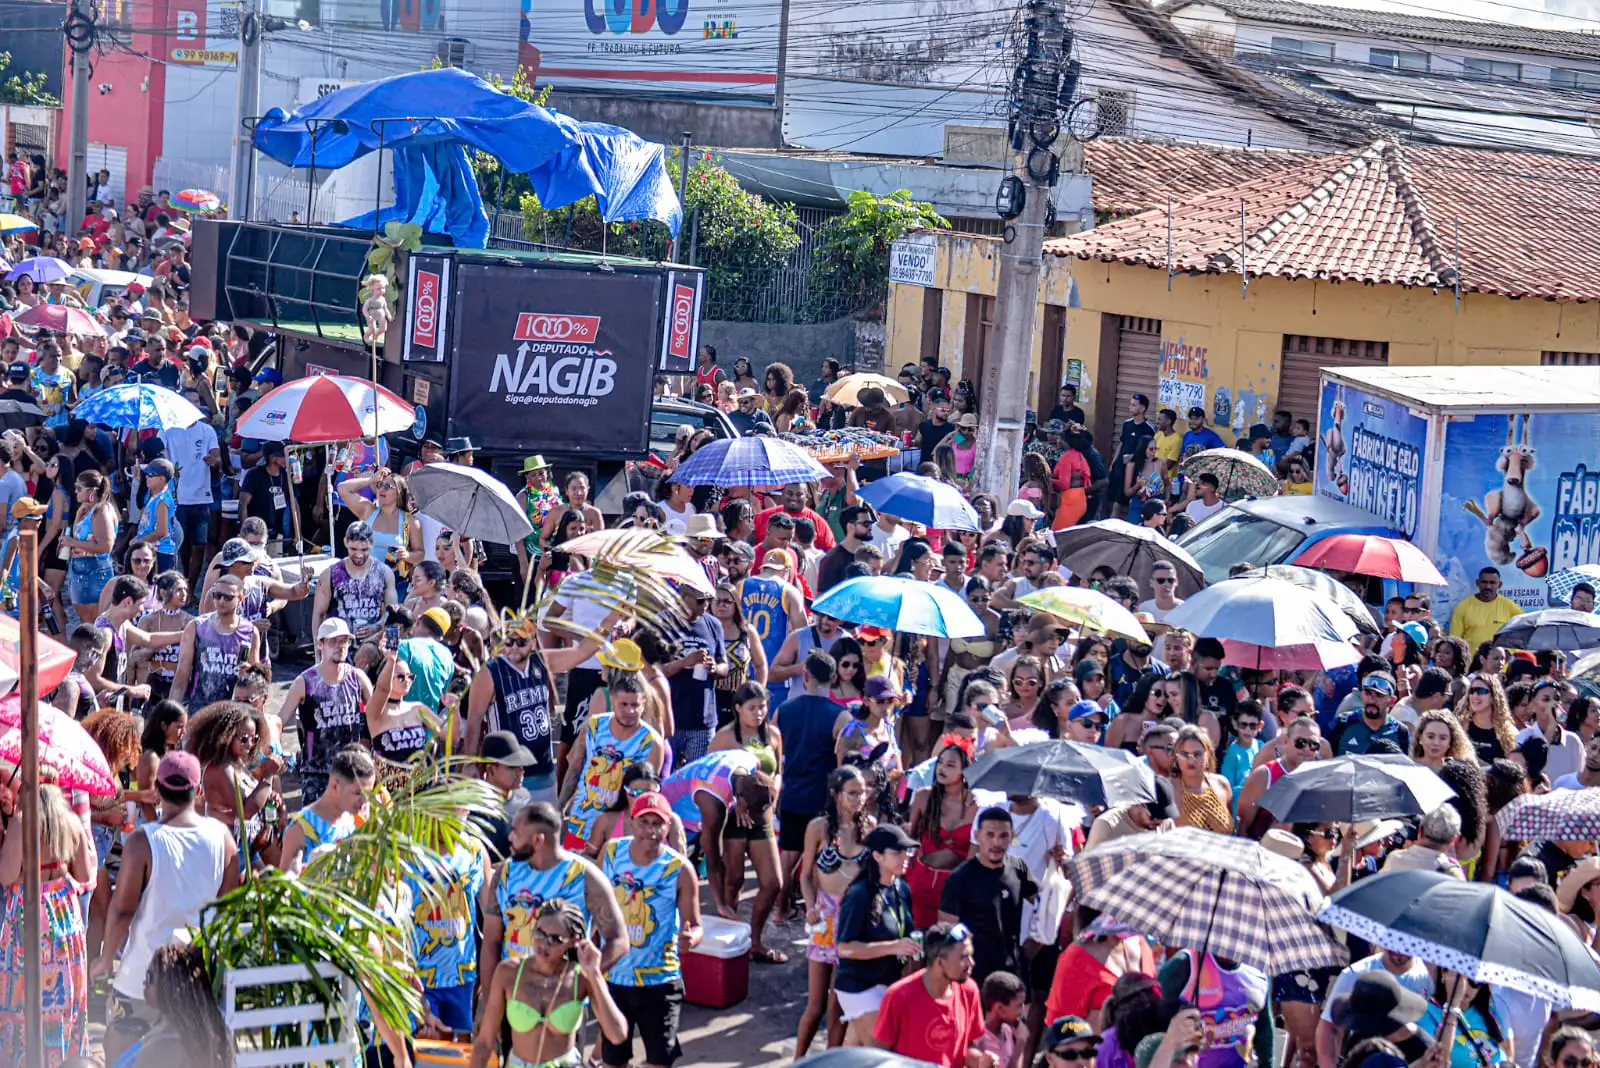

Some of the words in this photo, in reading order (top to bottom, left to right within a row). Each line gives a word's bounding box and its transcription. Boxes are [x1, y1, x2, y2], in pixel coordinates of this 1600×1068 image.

[177, 11, 199, 40] B
[898, 252, 926, 269] VENDO
[531, 343, 588, 356] DEPUTADO
[488, 346, 618, 397] NAGIB
[1352, 430, 1385, 466] FÁBRICA
[1386, 443, 1397, 470] DE
[1397, 447, 1419, 478] GELO
[1558, 472, 1600, 515] FÁB
[1514, 588, 1540, 597] ESCAMA
[1520, 598, 1545, 607] VAREJO
[520, 705, 550, 741] 33
